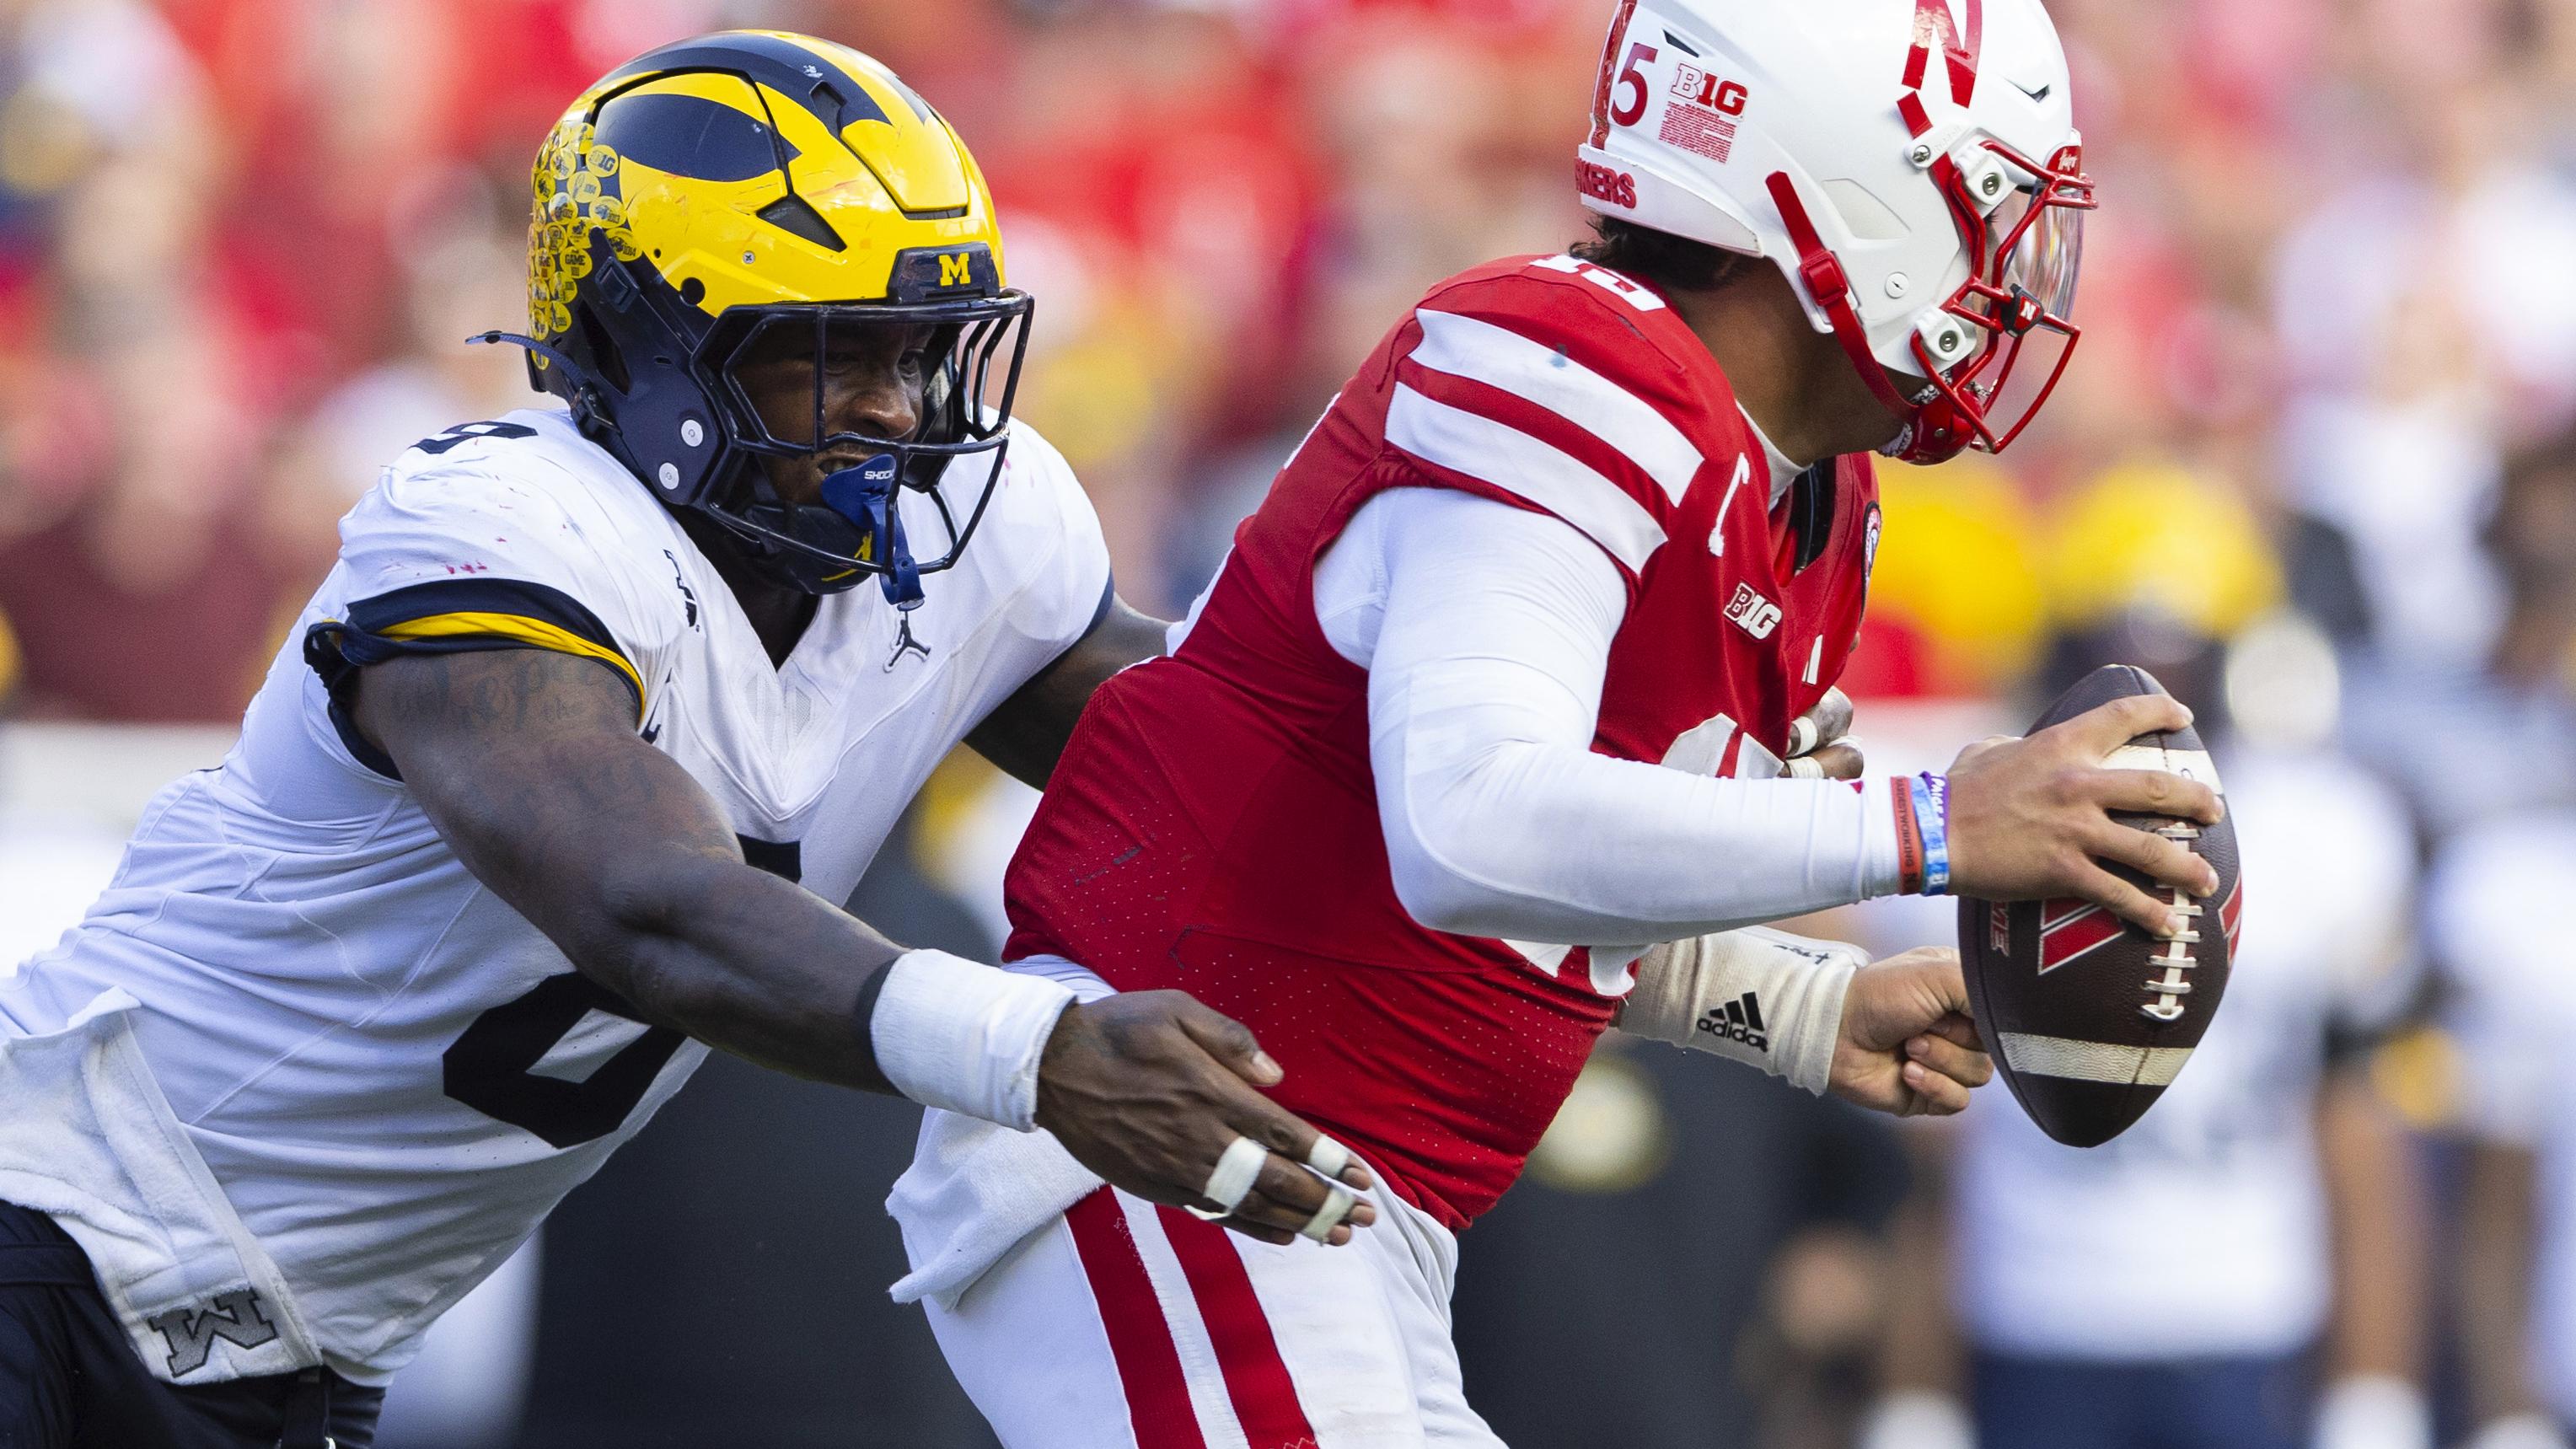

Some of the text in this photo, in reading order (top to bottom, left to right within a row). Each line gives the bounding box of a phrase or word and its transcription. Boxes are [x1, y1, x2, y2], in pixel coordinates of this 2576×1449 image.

[1610, 41, 1659, 127] 5
[1574, 156, 1637, 209] KERS
[938, 252, 971, 287] M
[2020, 300, 2037, 321] N
[1697, 1017, 1768, 1053] adidas
